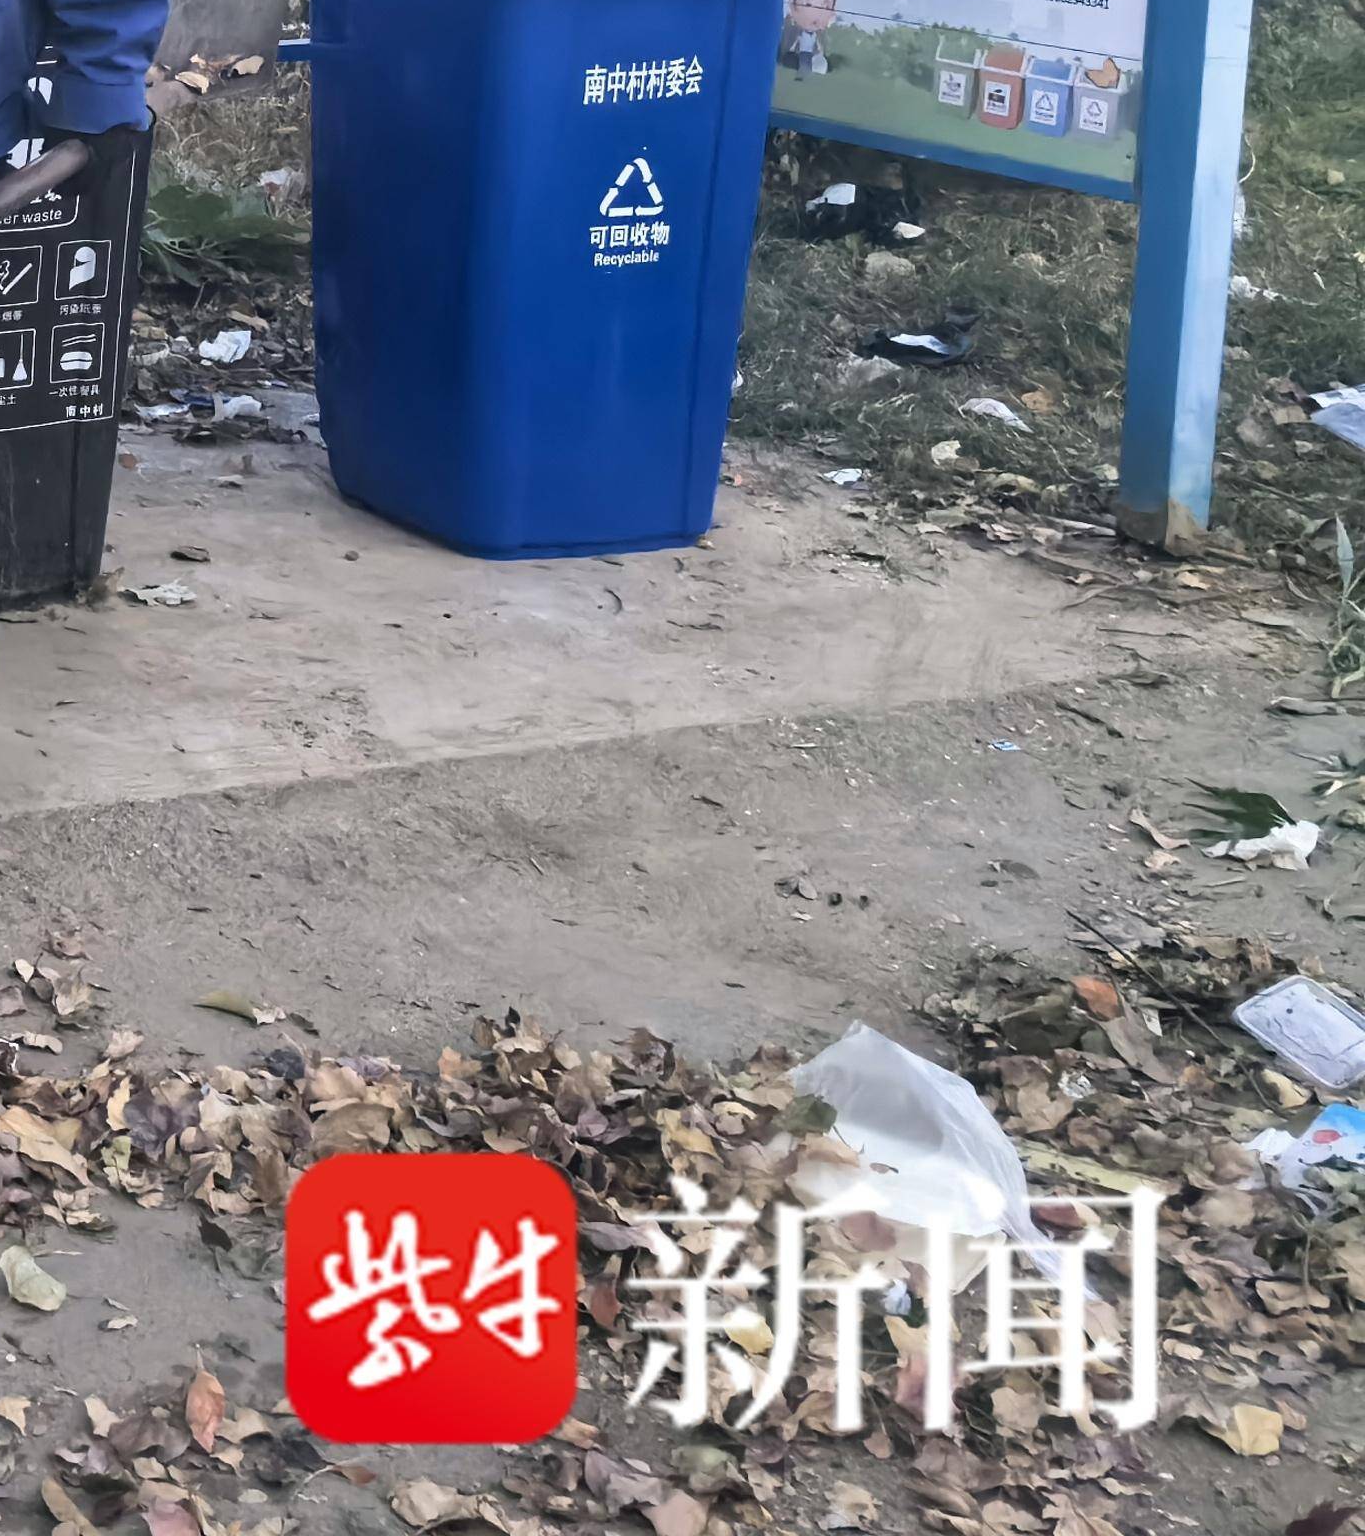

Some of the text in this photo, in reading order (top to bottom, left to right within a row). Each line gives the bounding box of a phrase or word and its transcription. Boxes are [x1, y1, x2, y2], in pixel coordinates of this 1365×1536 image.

[583, 54, 703, 105] 南中村村委会
[22, 208, 62, 224] waste
[589, 221, 670, 249] 可回收物
[594, 249, 659, 268] Recyclable
